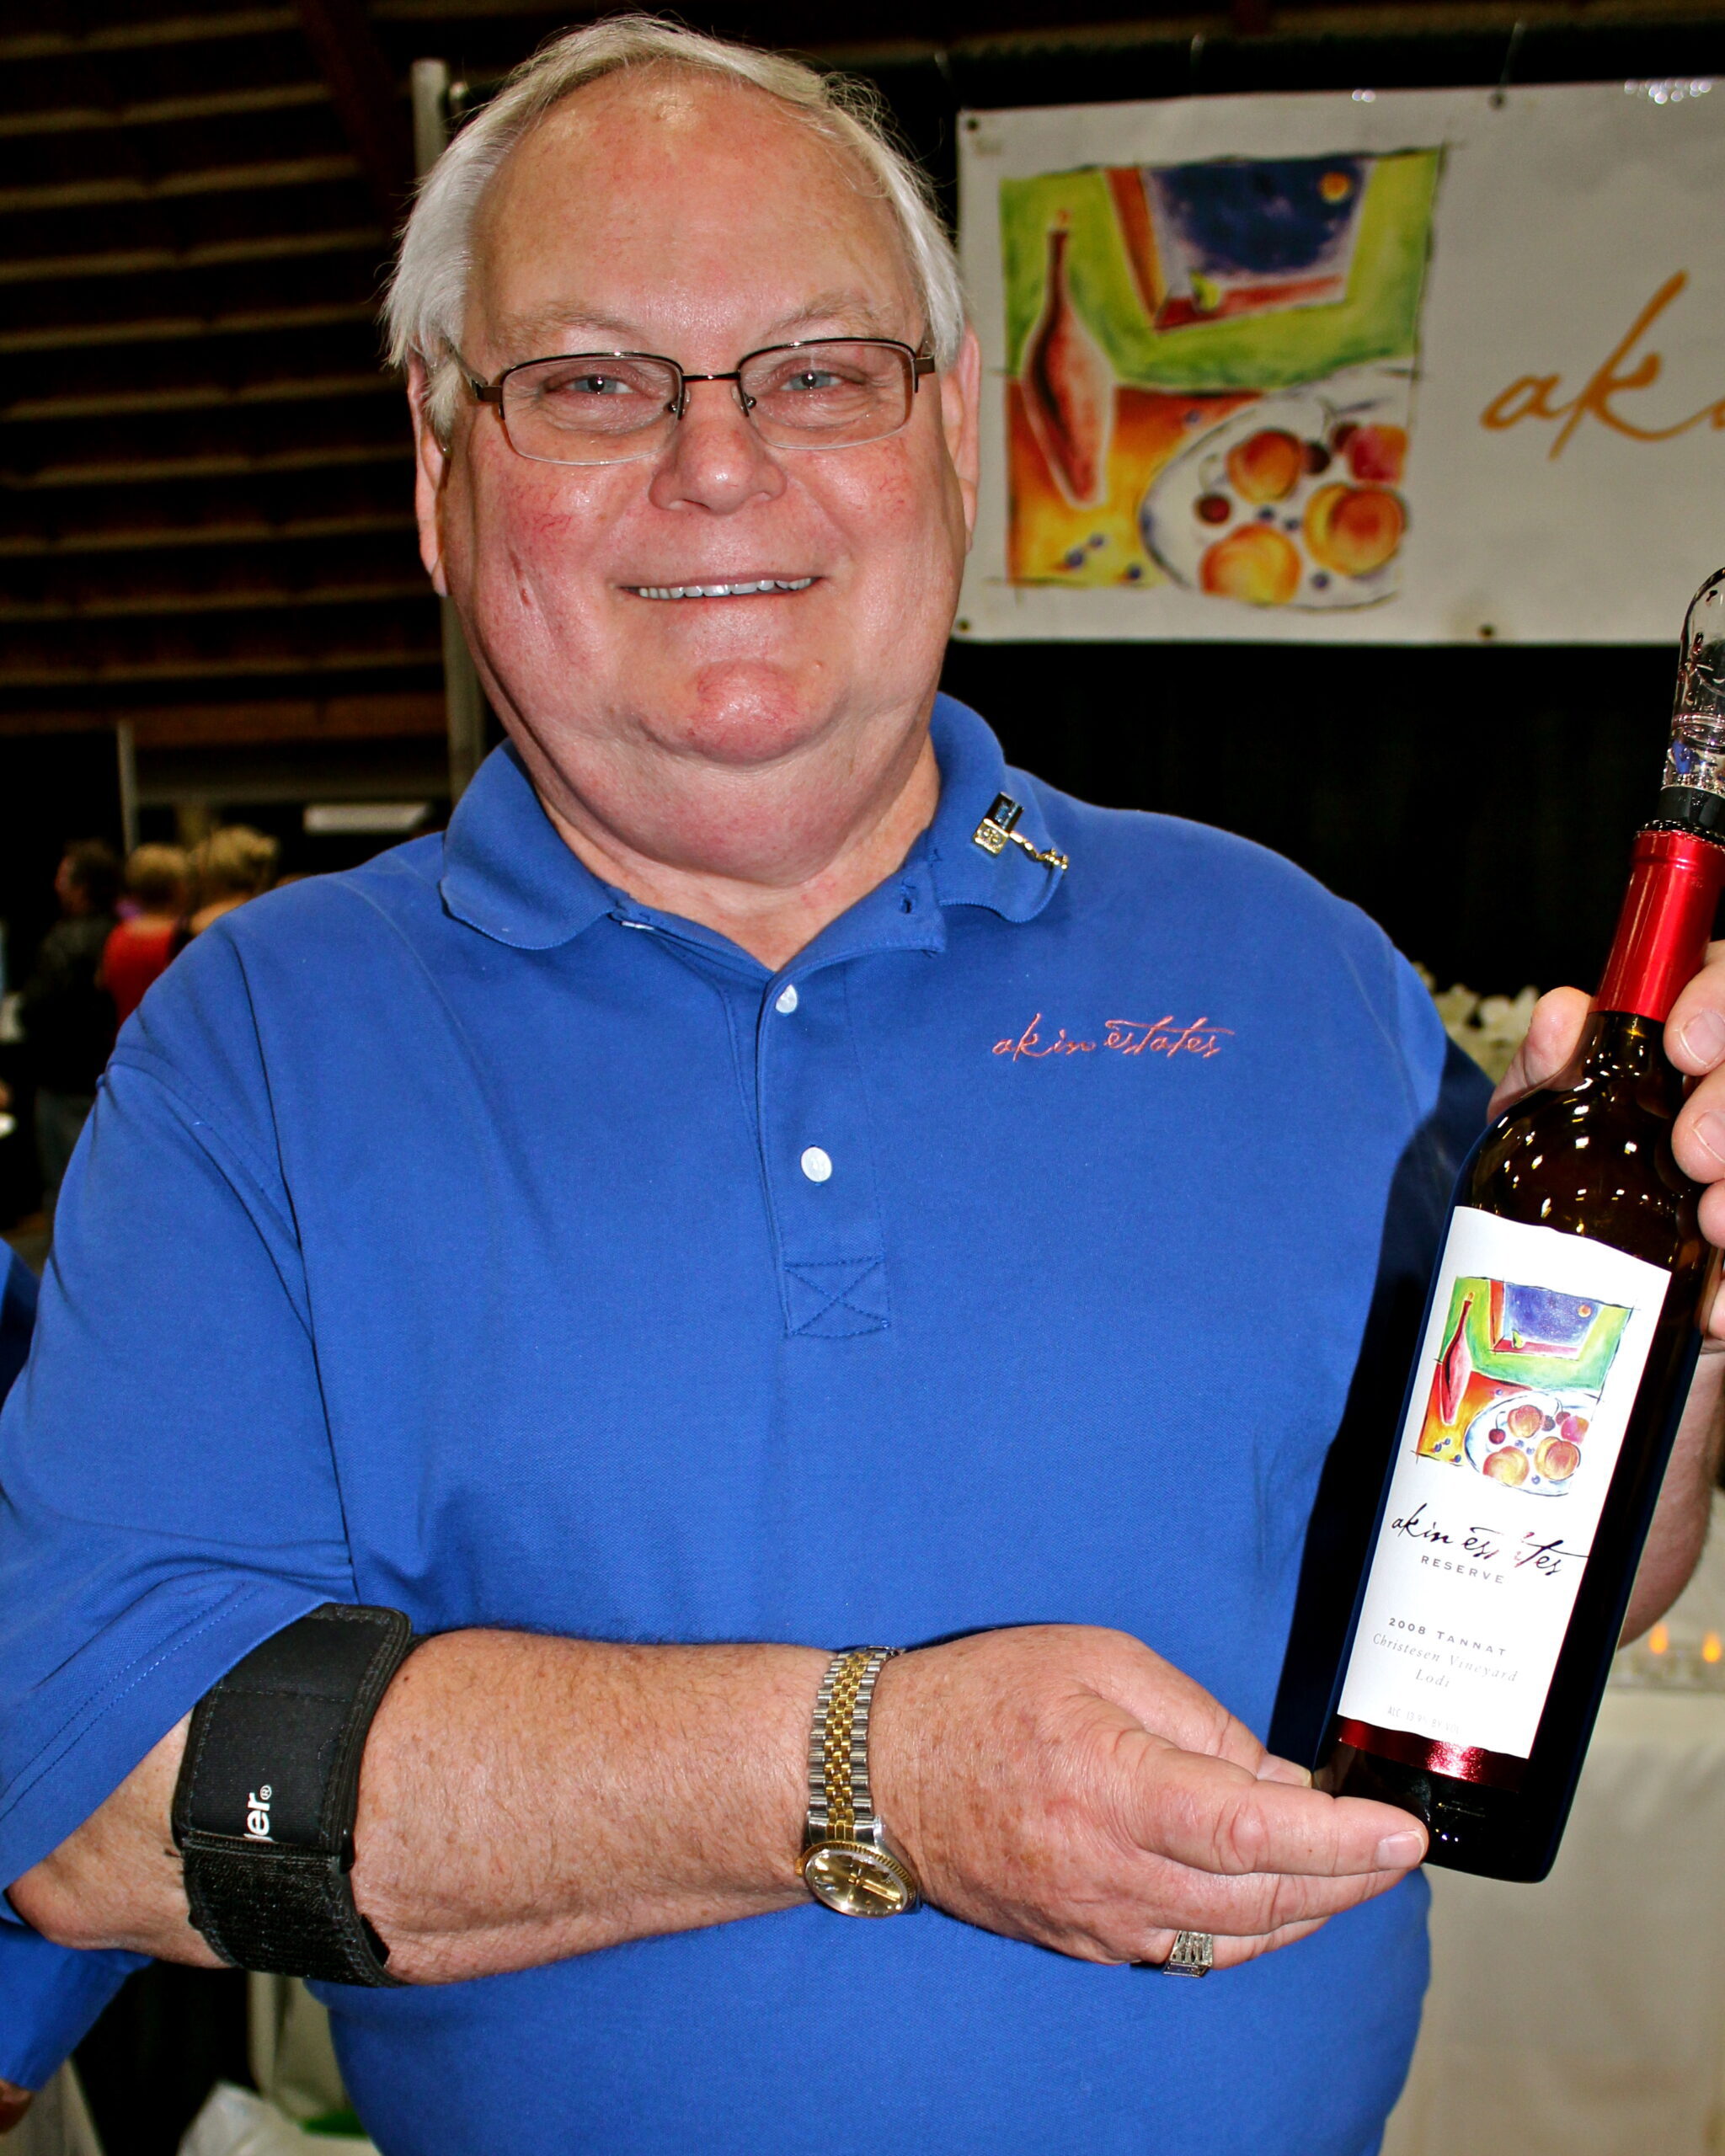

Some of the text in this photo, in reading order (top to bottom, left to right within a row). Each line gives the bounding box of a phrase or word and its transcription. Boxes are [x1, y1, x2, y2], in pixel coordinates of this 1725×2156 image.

[991, 1012, 1235, 1063] akin estates
[1391, 1502, 1454, 1544] akin
[1421, 1555, 1505, 1584] RESERVE
[1372, 1632, 1519, 1683] Christesen Vineyard
[1389, 1617, 1507, 1657] 2008 TANNAT
[1415, 1668, 1450, 1688] Lodi
